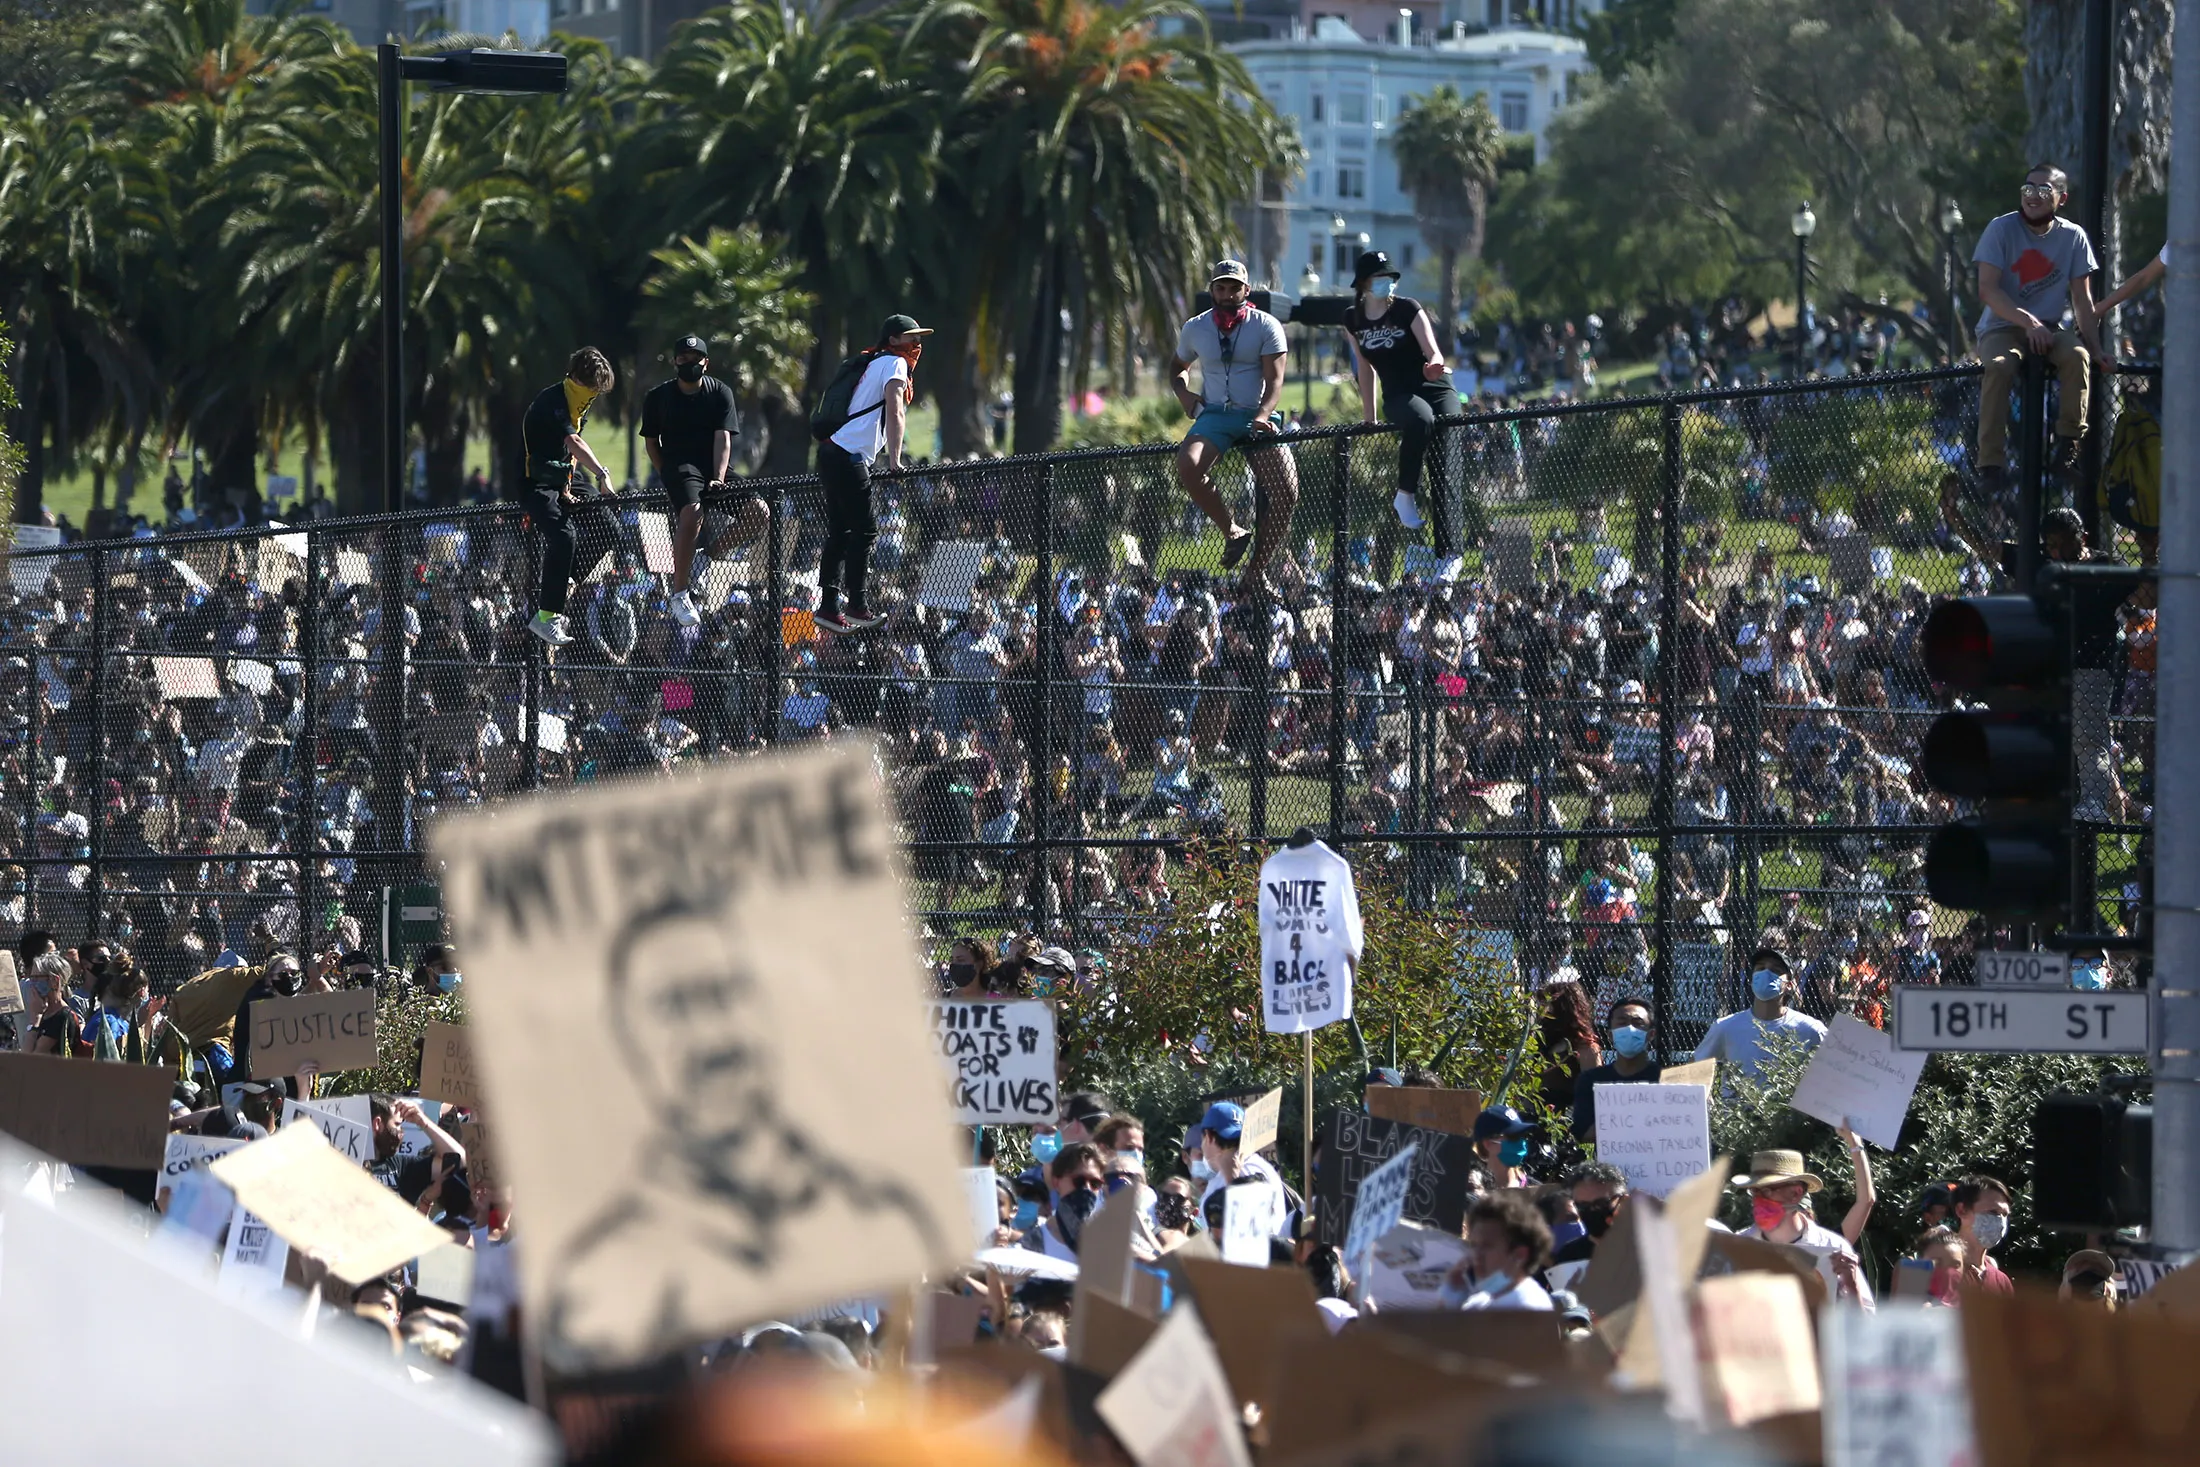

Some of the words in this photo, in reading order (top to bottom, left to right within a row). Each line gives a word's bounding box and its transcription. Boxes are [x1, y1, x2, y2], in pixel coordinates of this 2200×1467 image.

[1290, 932, 1303, 961] 4
[1274, 960, 1327, 985] BACK
[1986, 958, 2041, 981] 3700
[930, 1004, 1006, 1031] HITE
[1931, 1002, 2007, 1037] 18TH
[2066, 1004, 2115, 1039] ST
[258, 1010, 369, 1050] JUSTICE
[444, 1061, 477, 1077] LIVE
[958, 1053, 1000, 1077] FOR
[984, 1079, 1054, 1115] LIVES
[1598, 1091, 1657, 1106] MICHAEL
[1599, 1115, 1634, 1131] ERIC
[1644, 1114, 1694, 1127] GARNER
[1601, 1139, 1653, 1156] BREONNA
[1658, 1136, 1703, 1153] TAYLOR
[1656, 1161, 1704, 1178] FLOYD
